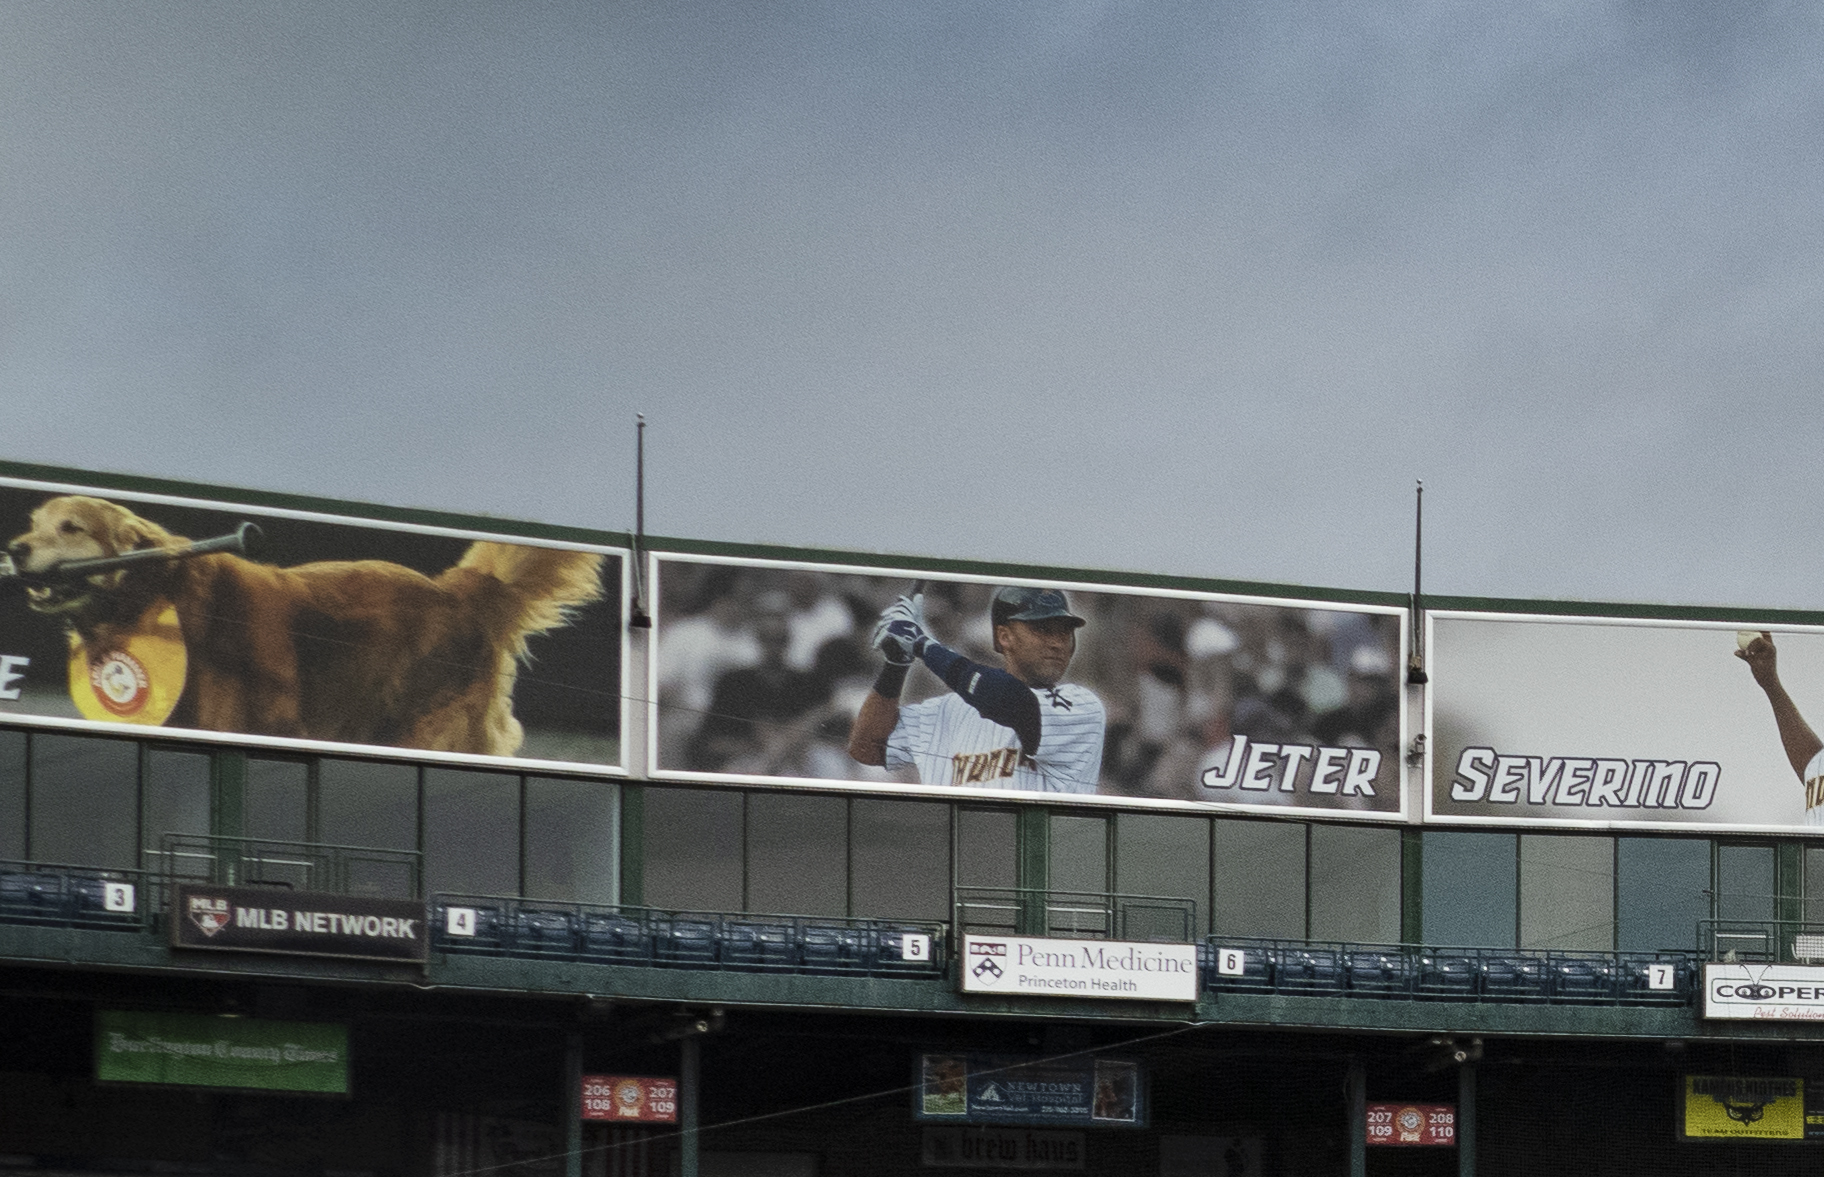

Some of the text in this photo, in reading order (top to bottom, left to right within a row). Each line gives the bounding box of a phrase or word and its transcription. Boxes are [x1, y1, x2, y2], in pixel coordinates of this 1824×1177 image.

[1202, 733, 1381, 797] JETER
[1450, 746, 1721, 810] SEVERINO
[114, 888, 125, 906] 3
[191, 898, 227, 911] MLB
[237, 907, 415, 939] MLB NETWORK
[455, 913, 466, 930] 4
[911, 940, 921, 956] 5
[1016, 943, 1193, 974] Penn Medicine
[1227, 953, 1236, 970] 6
[1018, 974, 1138, 993] Princeton Health
[1657, 969, 1666, 986] 7
[584, 1084, 611, 1096] 206
[649, 1086, 676, 1098] 207
[1006, 1081, 1082, 1092] NEWTOWN
[585, 1099, 611, 1110] 108
[649, 1101, 675, 1113] 109
[1367, 1111, 1392, 1123] 207
[1429, 1113, 1454, 1124] 208
[1368, 1126, 1392, 1136] 109
[1429, 1126, 1454, 1137] 110
